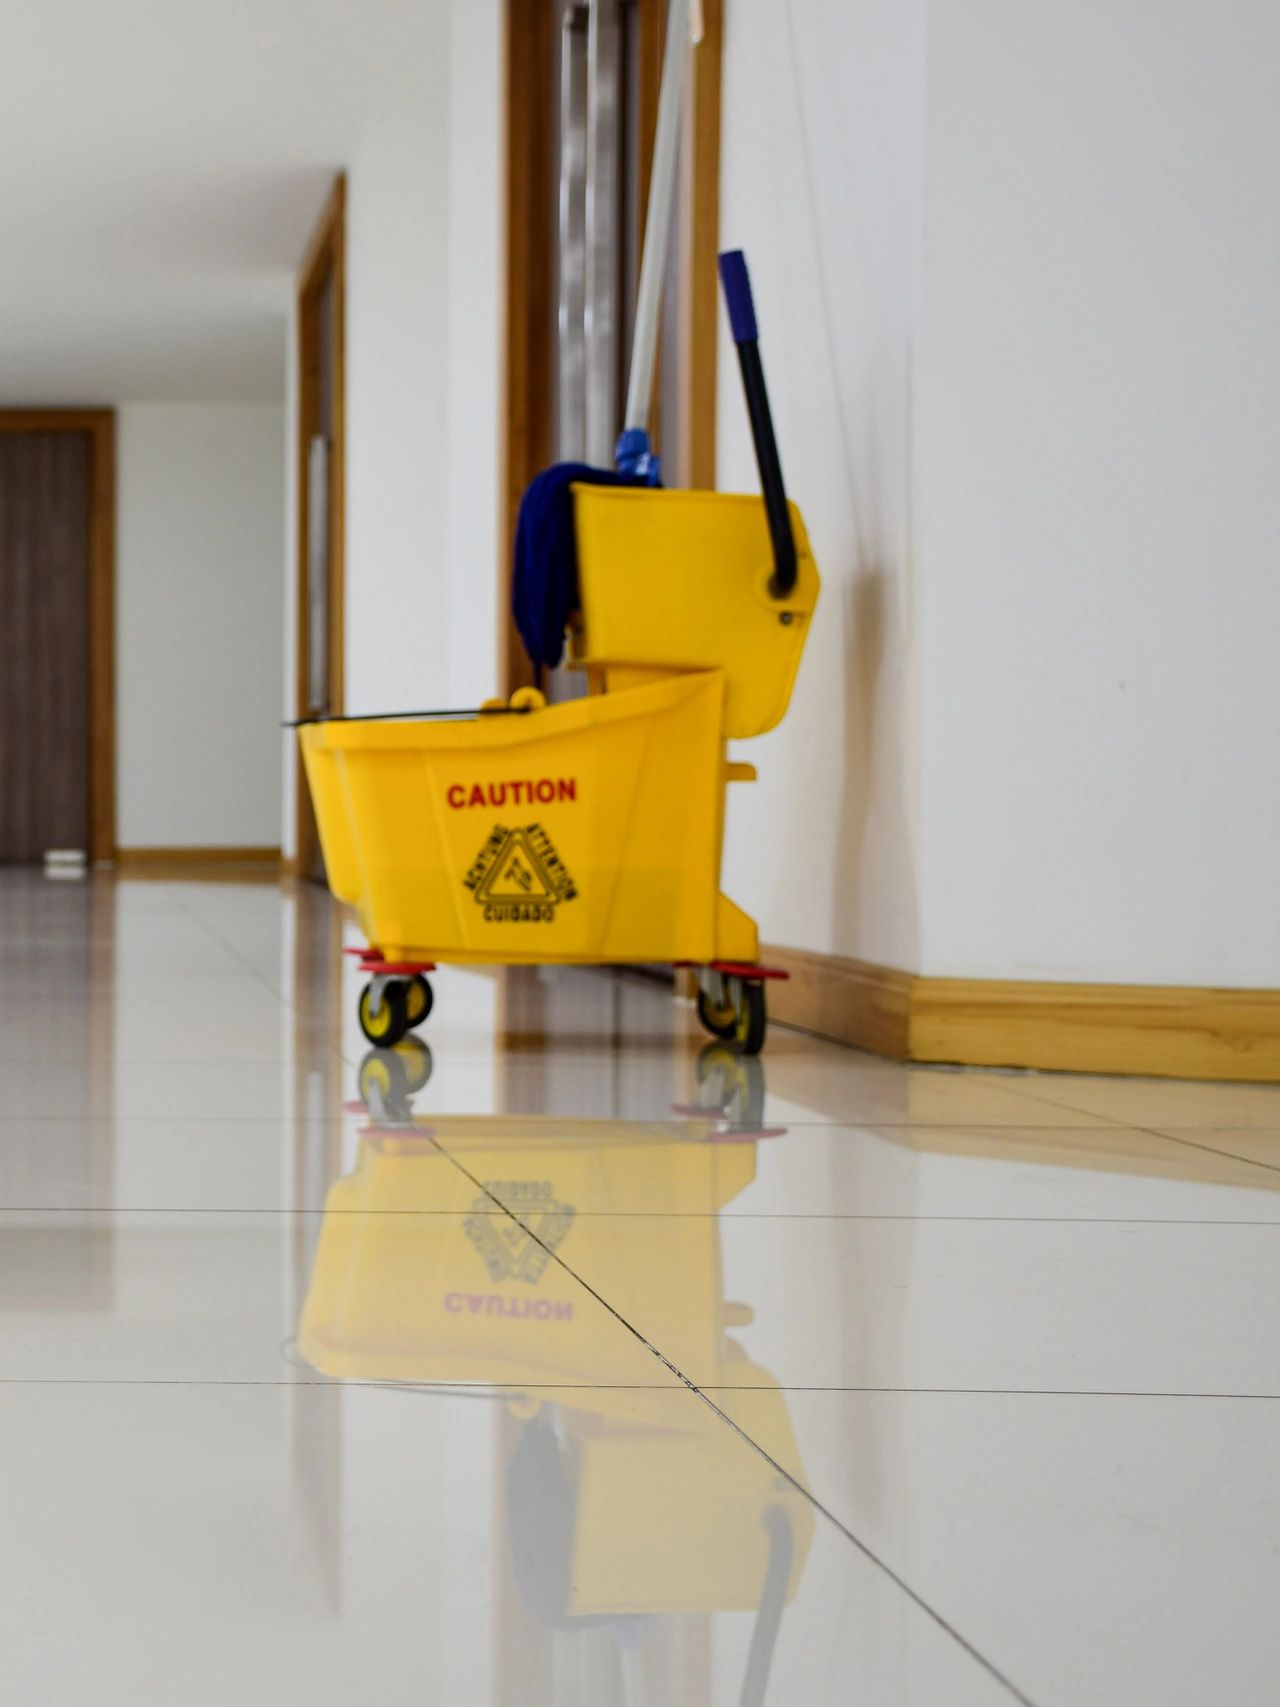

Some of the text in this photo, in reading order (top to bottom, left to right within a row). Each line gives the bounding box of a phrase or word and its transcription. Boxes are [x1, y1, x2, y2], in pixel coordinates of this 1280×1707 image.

[447, 778, 577, 809] CAUTION
[526, 823, 578, 900] ATTENTION
[483, 903, 555, 922] CUIDADO
